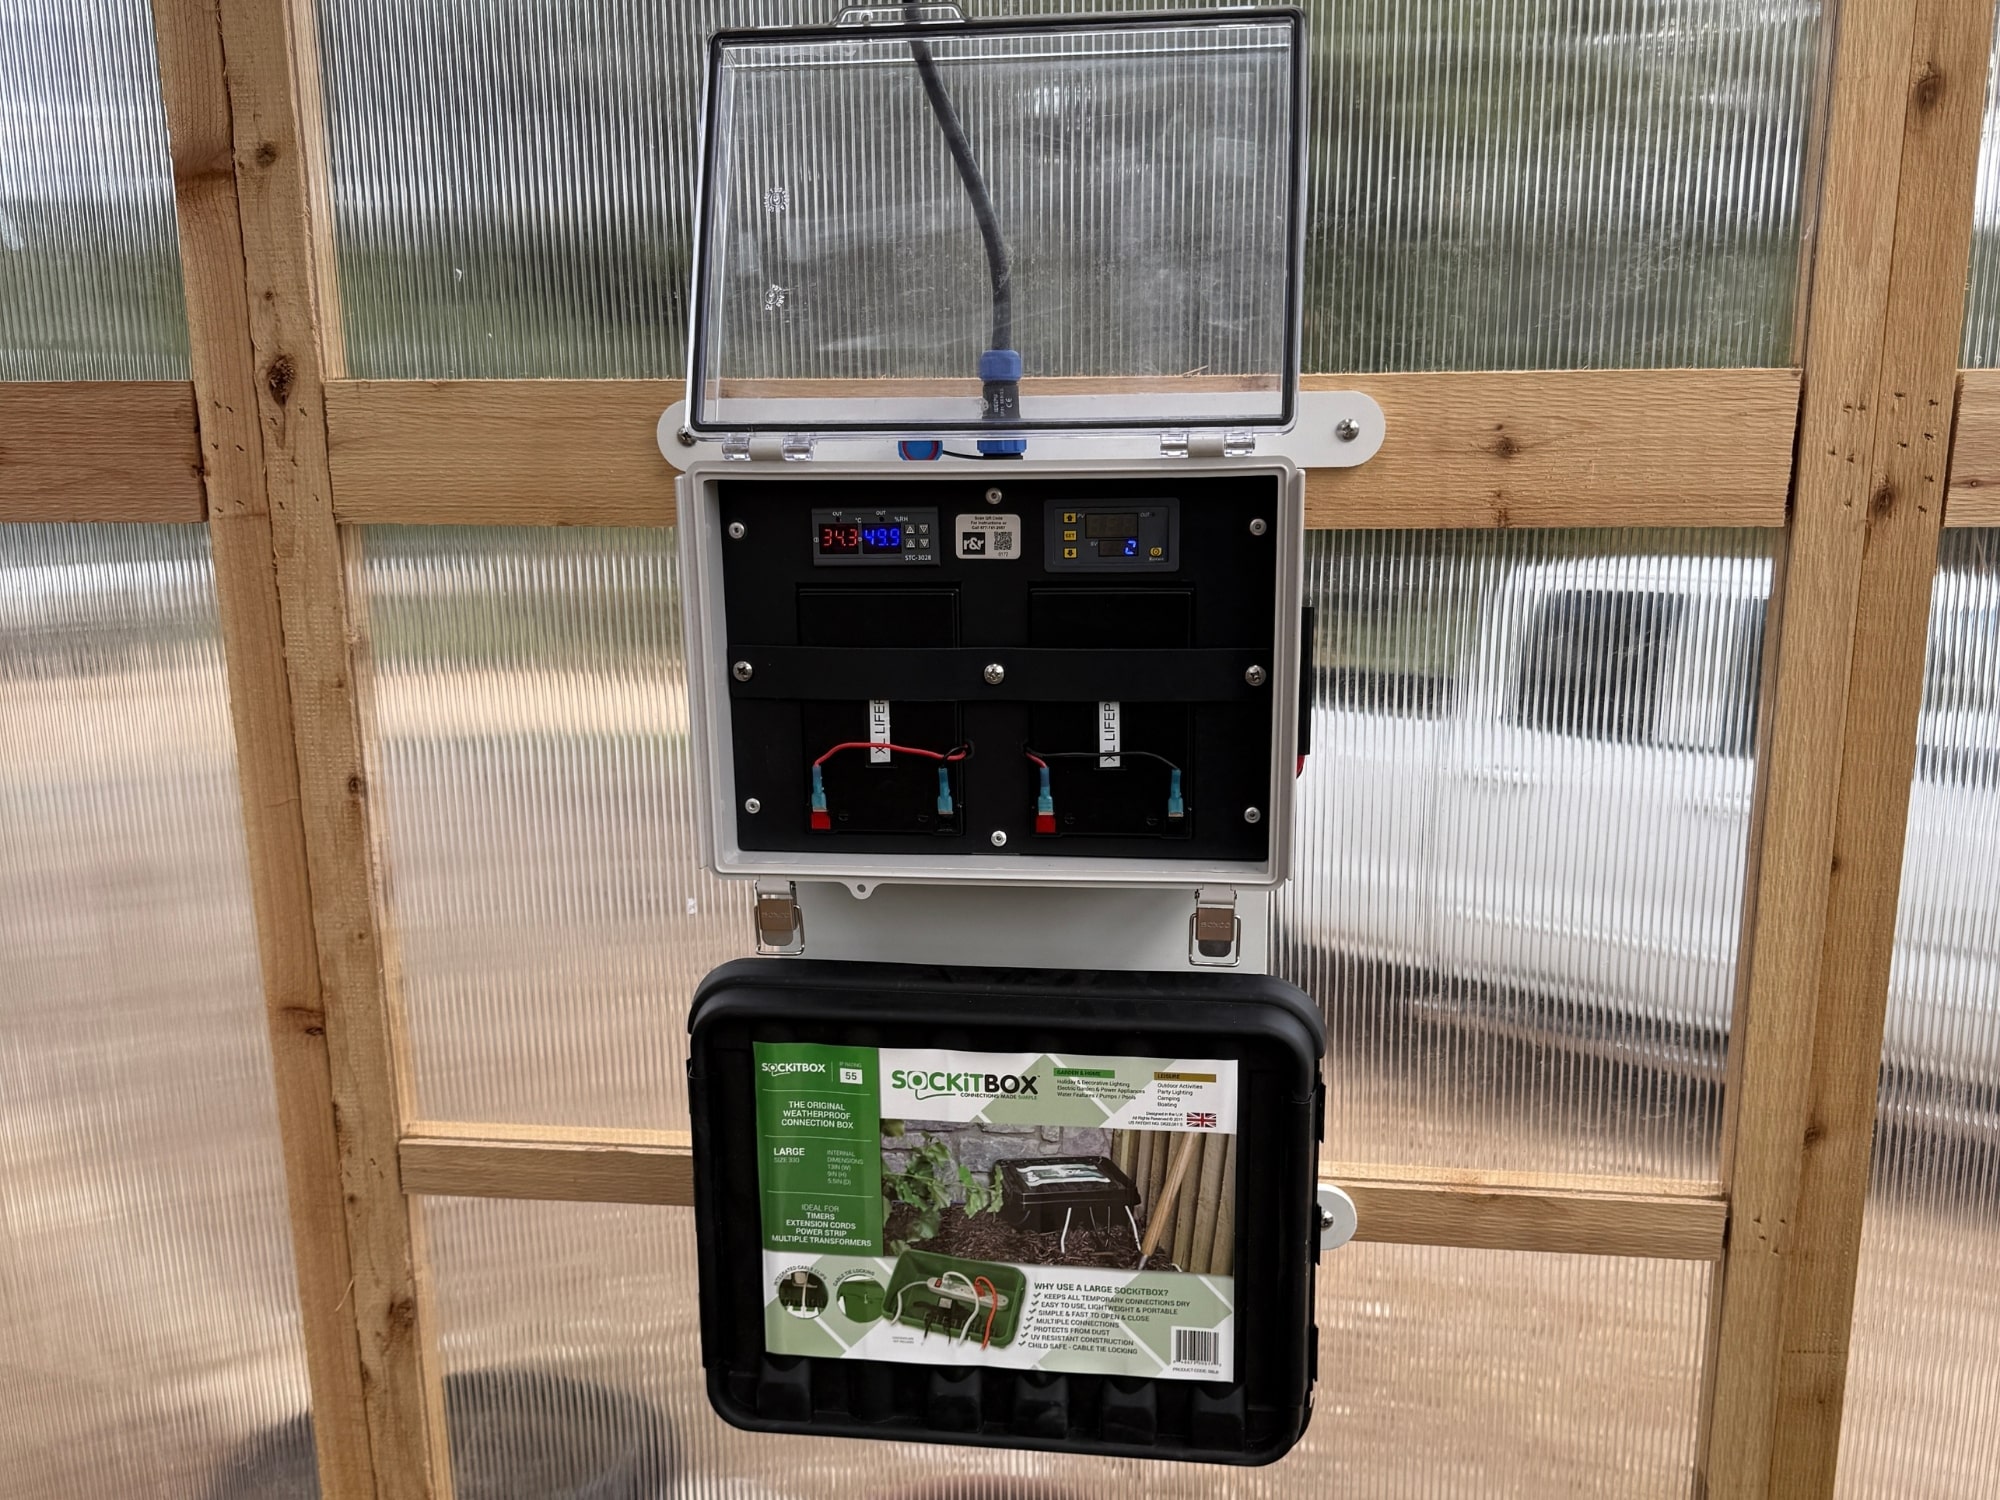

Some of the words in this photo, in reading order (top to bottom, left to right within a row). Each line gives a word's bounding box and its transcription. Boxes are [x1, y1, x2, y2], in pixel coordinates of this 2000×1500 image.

[823, 529, 858, 546] 34.3
[864, 528, 900, 546] 49.9
[964, 537, 984, 550] r&r
[1104, 703, 1115, 741] LIFEP
[845, 1071, 857, 1080] 55
[807, 1101, 846, 1110] ORIGINAL
[783, 1110, 851, 1120] WEATHERPROOF
[781, 1119, 835, 1128] CONNECTION
[837, 1121, 854, 1129] BOX
[774, 1147, 805, 1156] LARGE
[806, 1212, 835, 1220] TIMERS
[786, 1219, 828, 1228] EXTENSION
[830, 1221, 856, 1230] CORDS
[795, 1228, 823, 1236] POWER
[825, 1229, 847, 1237] STRIP
[772, 1235, 808, 1243] MULTIPLE
[810, 1236, 872, 1246] TRANSFORMERS
[1034, 1282, 1055, 1290] WHY
[1057, 1283, 1074, 1291] USE
[1084, 1285, 1113, 1293] LARGE
[1082, 1295, 1124, 1304] TEMPORARY
[1126, 1297, 1175, 1306] CONNECTIONS
[1088, 1304, 1134, 1313] LIGHTWEIGHT
[1142, 1307, 1178, 1315] PORTABLE
[1101, 1312, 1119, 1320] OPEN
[1036, 1318, 1069, 1326] MULTIPLE
[1071, 1319, 1120, 1328] CONNECTIONS
[1034, 1326, 1068, 1334] PROTECTS
[1080, 1336, 1134, 1346] CONSTRUCTION
[1073, 1344, 1095, 1352] CABLE
[1108, 1346, 1138, 1355] LOCKING
